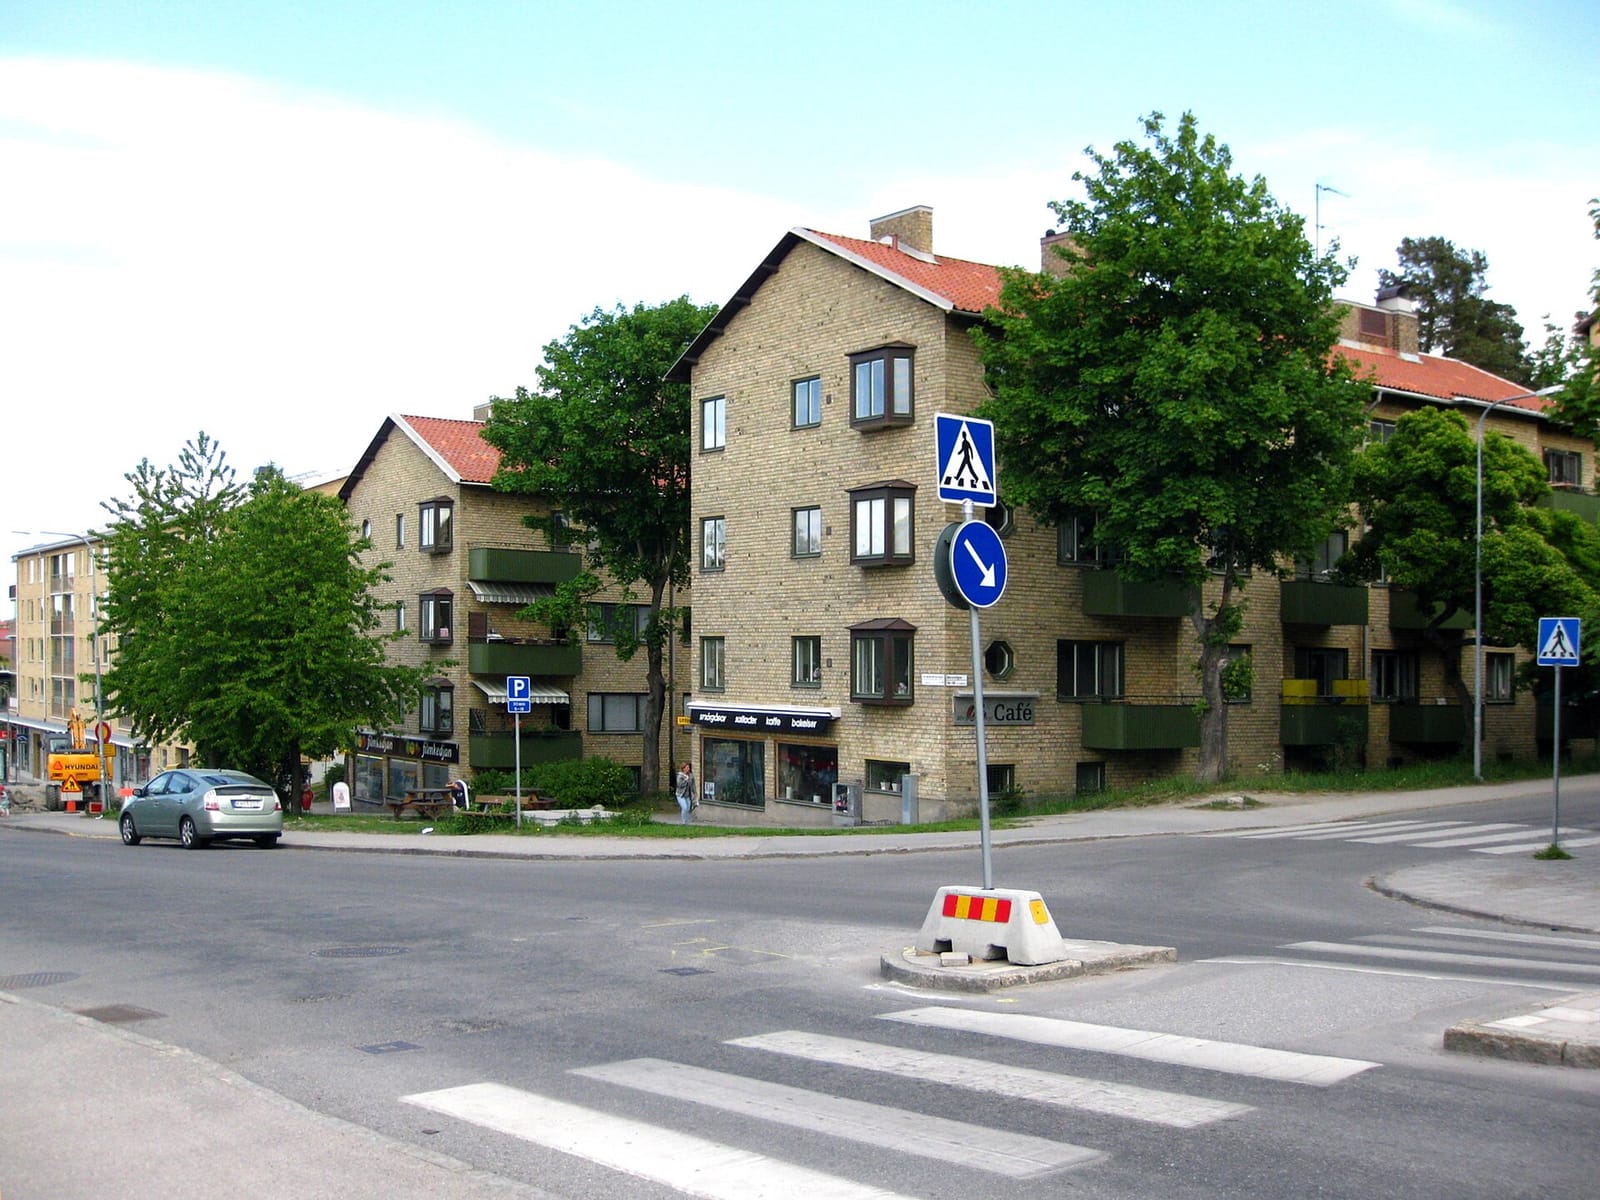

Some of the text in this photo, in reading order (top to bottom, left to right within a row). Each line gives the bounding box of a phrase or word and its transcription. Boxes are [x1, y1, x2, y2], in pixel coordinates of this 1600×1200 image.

[514, 679, 525, 697] P
[994, 701, 1032, 722] Café
[766, 716, 782, 727] kaffe
